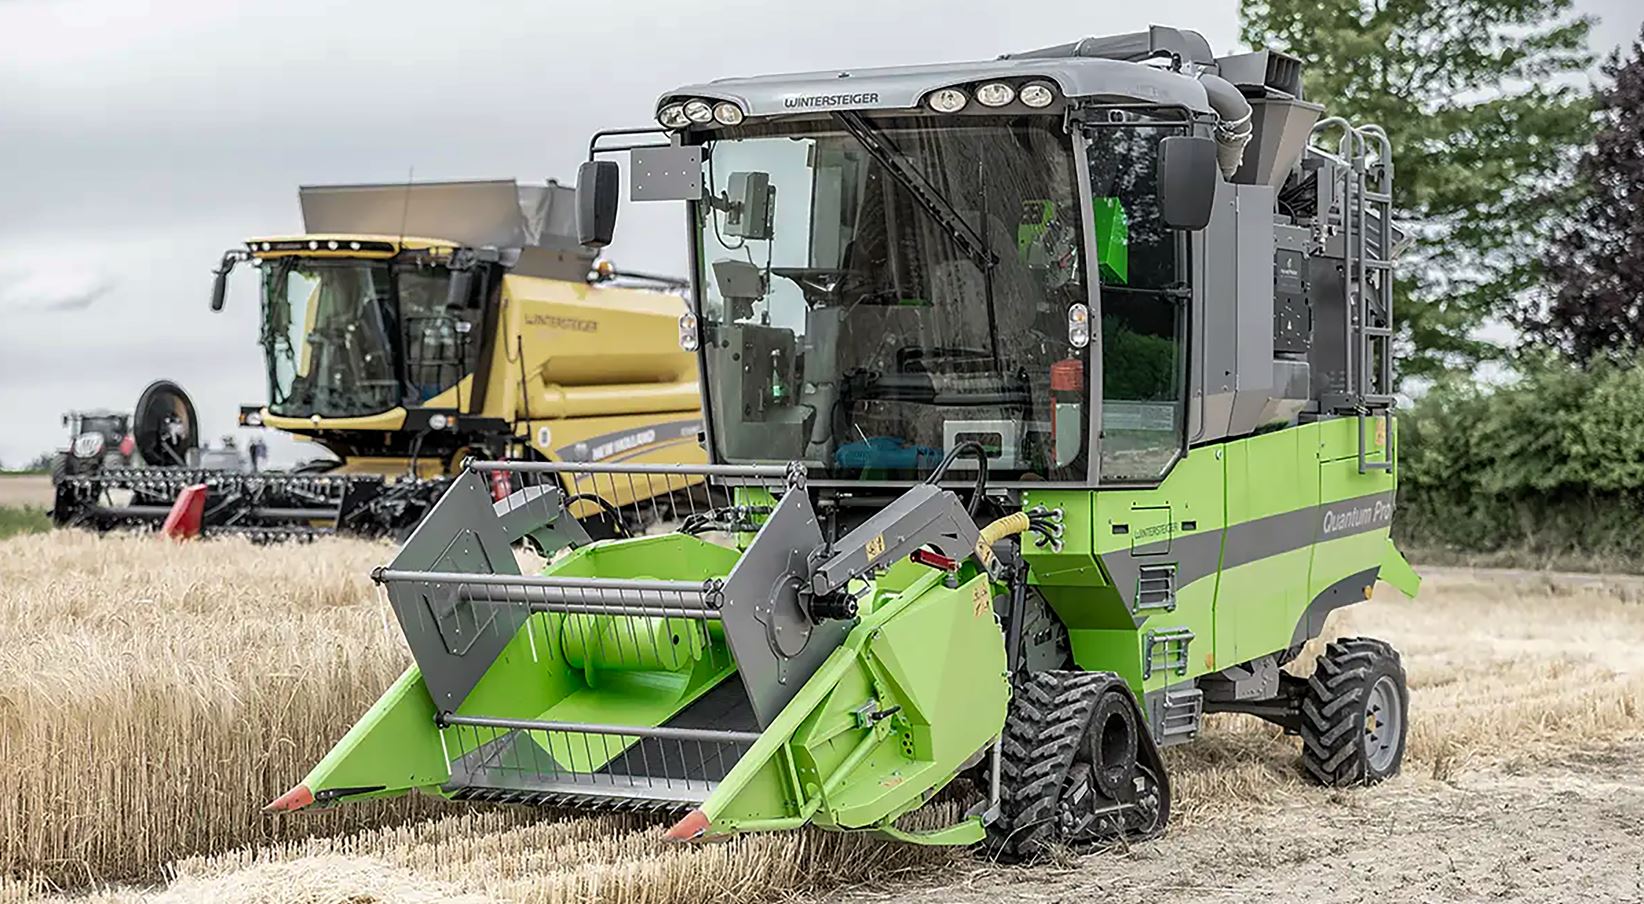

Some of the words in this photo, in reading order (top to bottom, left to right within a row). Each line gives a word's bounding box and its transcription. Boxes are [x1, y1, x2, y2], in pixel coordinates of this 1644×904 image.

[784, 92, 879, 108] WINTERSTEIGER
[1323, 507, 1372, 533] Quantum
[1373, 500, 1391, 522] Pro
